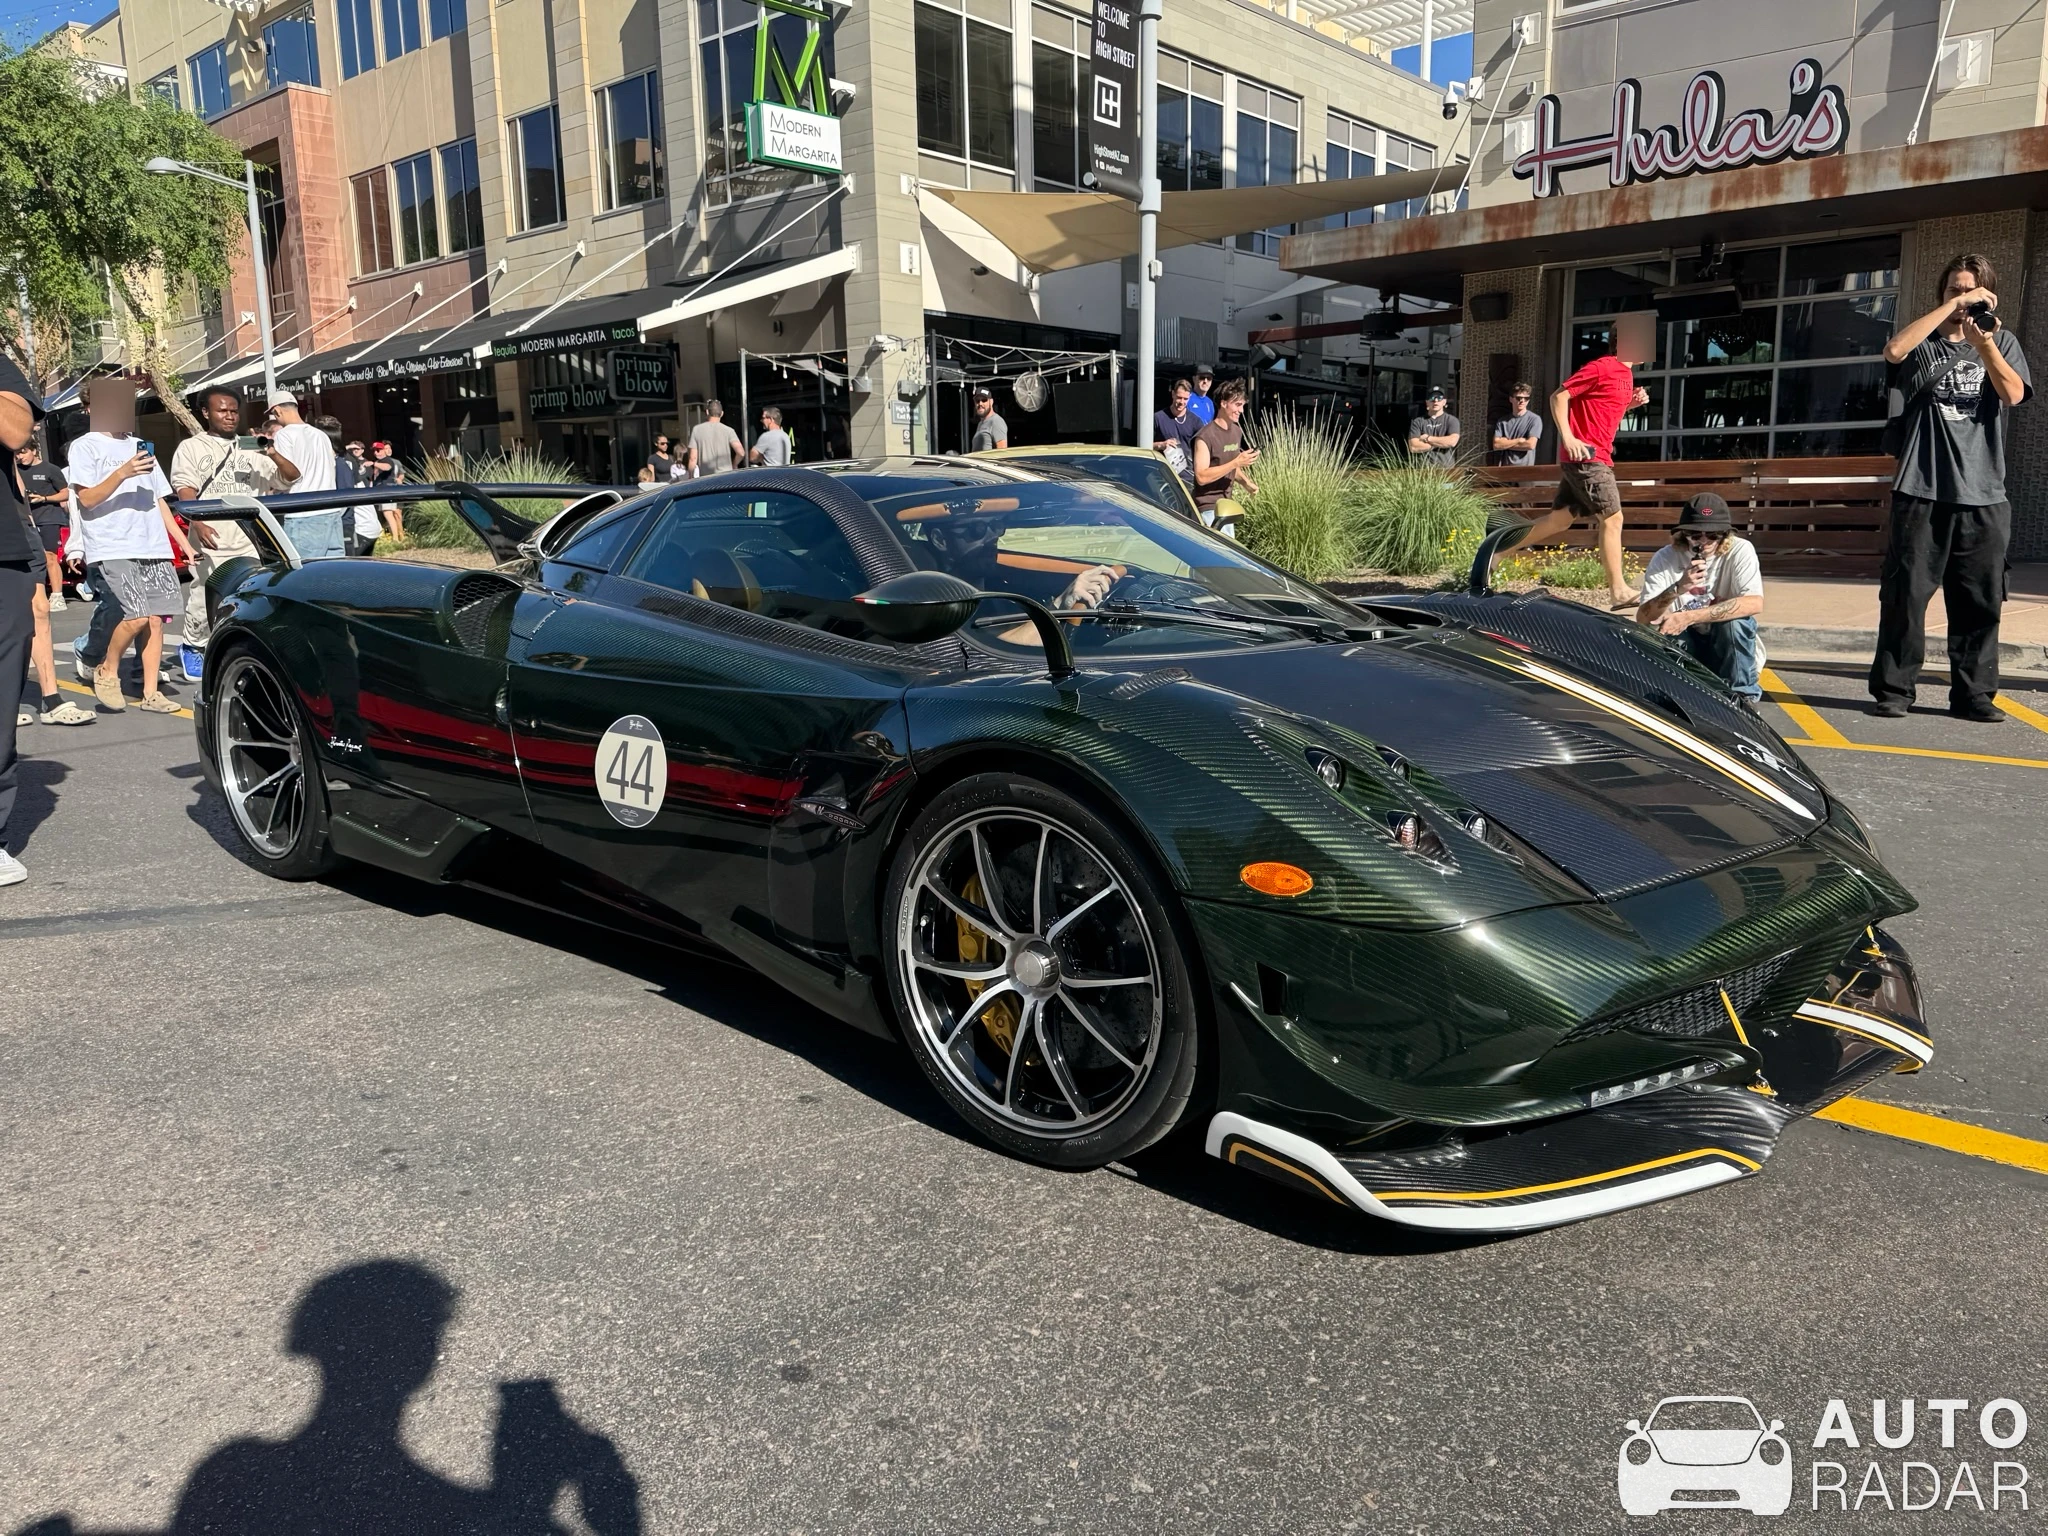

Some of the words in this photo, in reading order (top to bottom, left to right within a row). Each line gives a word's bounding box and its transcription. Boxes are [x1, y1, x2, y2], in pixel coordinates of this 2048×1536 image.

[1096, 19, 1106, 38] TO
[1097, 0, 1130, 30] WELCOME
[1095, 38, 1112, 60] HIGH
[1112, 46, 1136, 69] STREET
[1513, 58, 1848, 198] Hula's
[494, 343, 518, 357] tequila
[520, 337, 555, 353] MODERN
[557, 330, 607, 348] MARGARITA
[612, 327, 636, 340] tacos
[616, 356, 662, 377] primp
[624, 371, 668, 394] blow
[529, 388, 568, 415] primp
[572, 384, 607, 407] blow
[606, 740, 654, 805] 44
